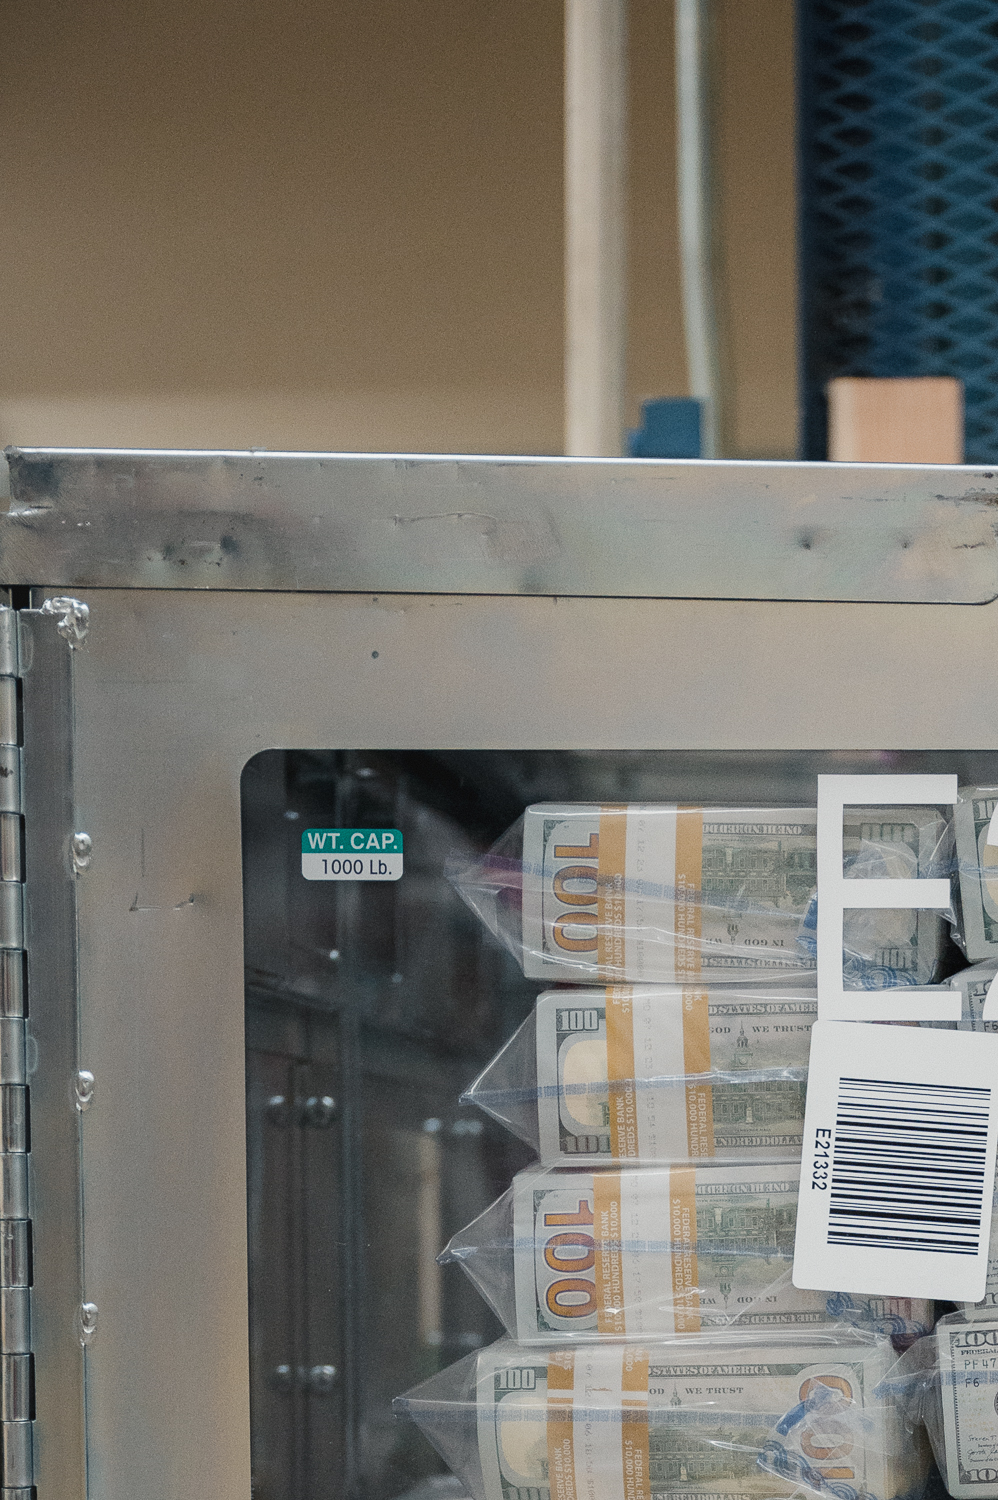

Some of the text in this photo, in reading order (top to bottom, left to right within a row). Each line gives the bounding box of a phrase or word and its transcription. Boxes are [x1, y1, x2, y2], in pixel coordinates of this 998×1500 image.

[307, 832, 398, 850] WT. CAP.
[321, 859, 392, 875] 1000 Lb.
[559, 1009, 599, 1031] 100
[752, 1025, 770, 1033] WE
[983, 1021, 998, 1032] F6
[812, 1127, 832, 1191] E21332
[600, 1210, 609, 1235] BANK
[543, 1199, 598, 1319] 100
[964, 1359, 979, 1370] PF
[498, 1369, 537, 1390] 100
[965, 1377, 980, 1388] F6
[685, 1387, 703, 1395] WE
[635, 1449, 644, 1488] FEDERAL
